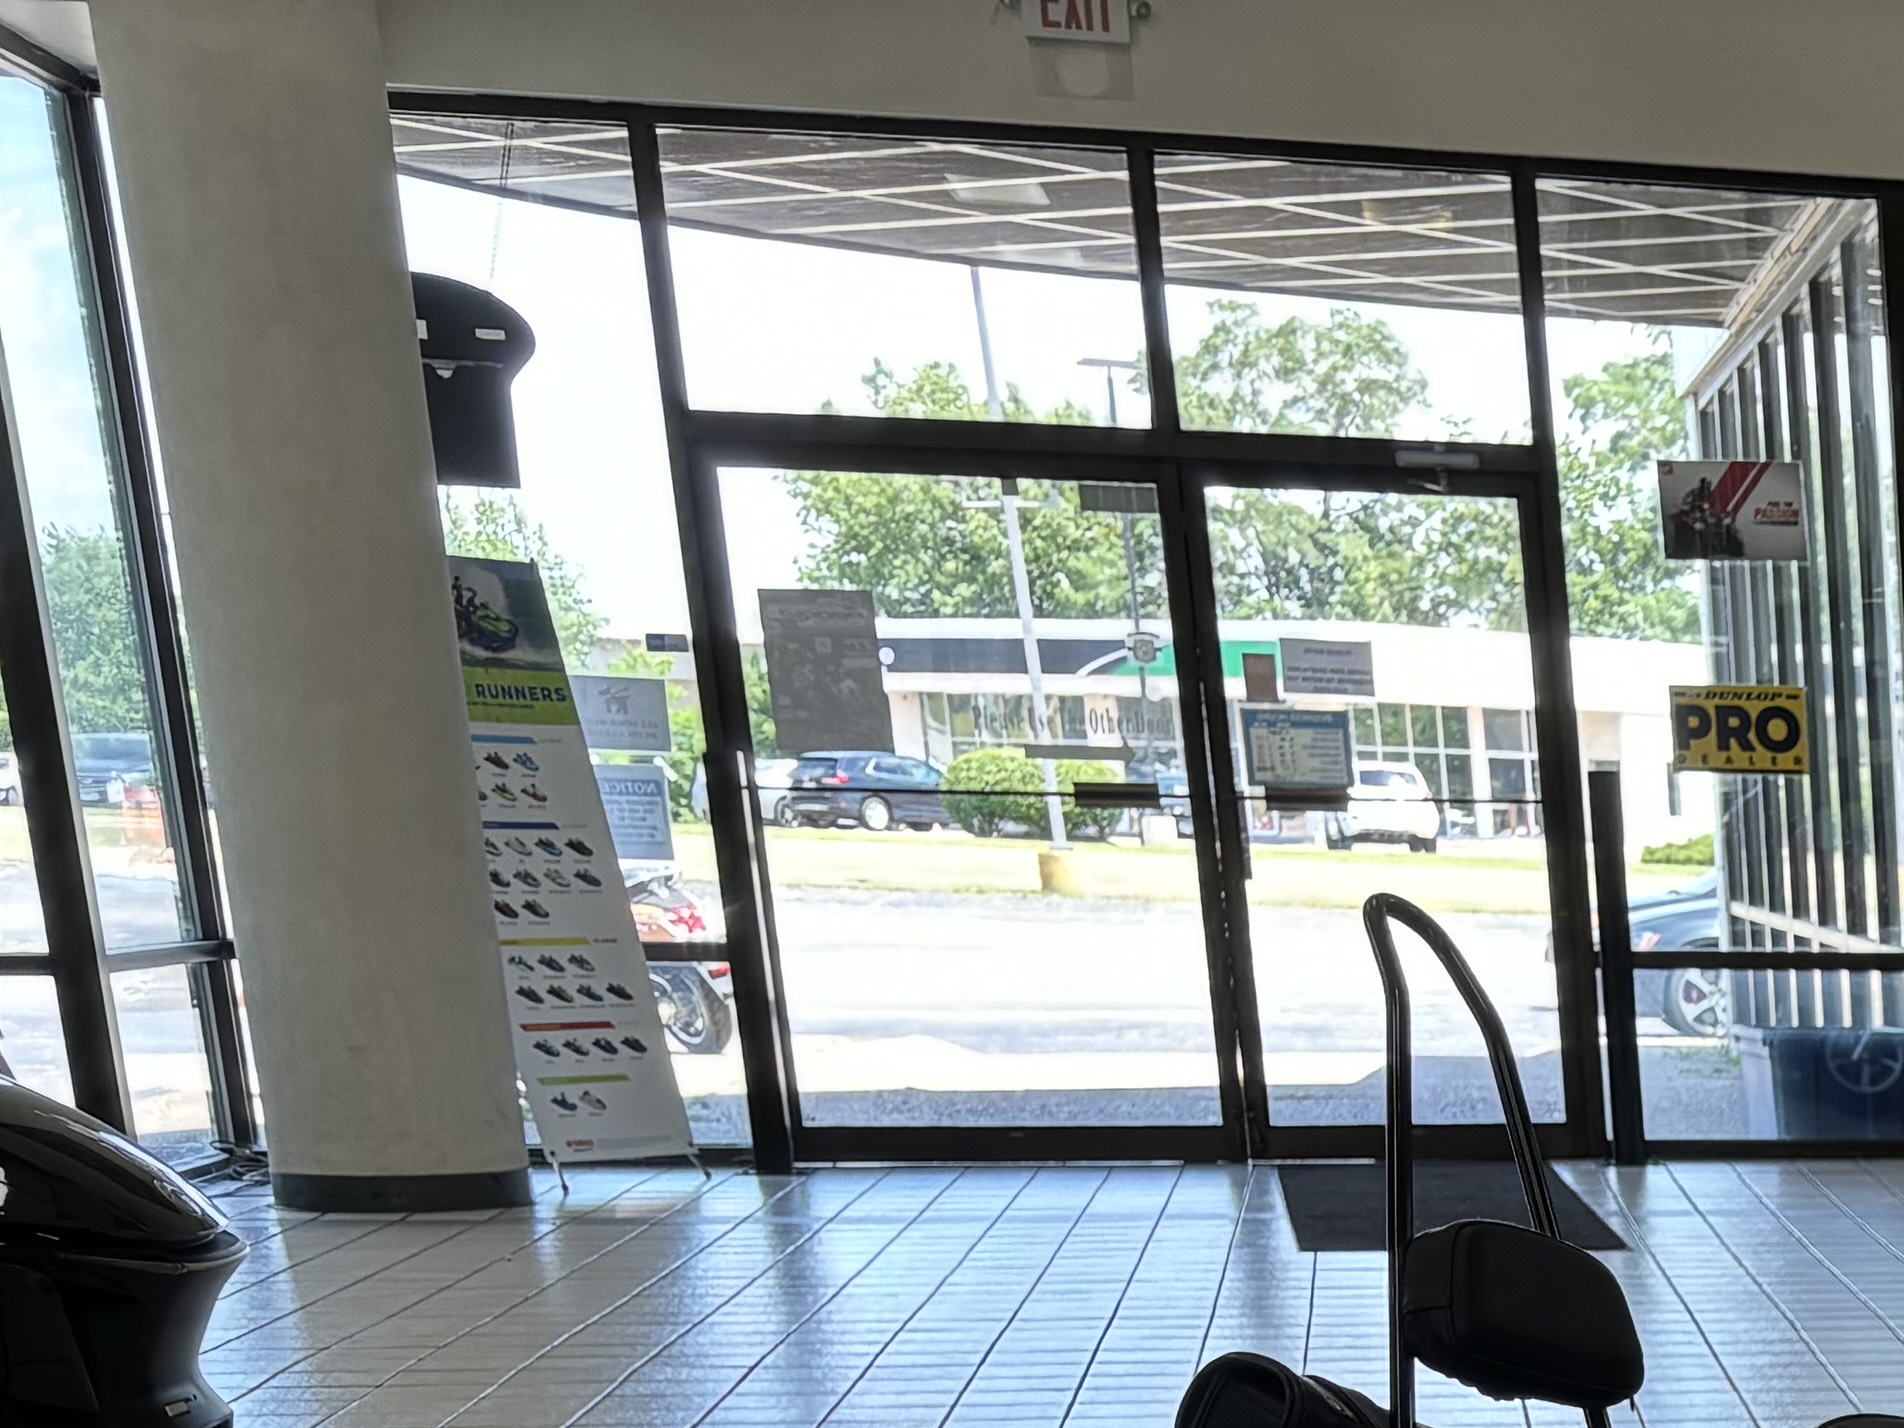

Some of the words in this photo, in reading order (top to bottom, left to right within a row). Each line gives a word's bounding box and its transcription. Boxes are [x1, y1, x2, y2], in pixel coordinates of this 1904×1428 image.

[475, 683, 567, 702] RUNNERS
[1705, 691, 1782, 700] DUNLOP
[1675, 704, 1800, 754] PRO
[1677, 753, 1803, 766] DEALER
